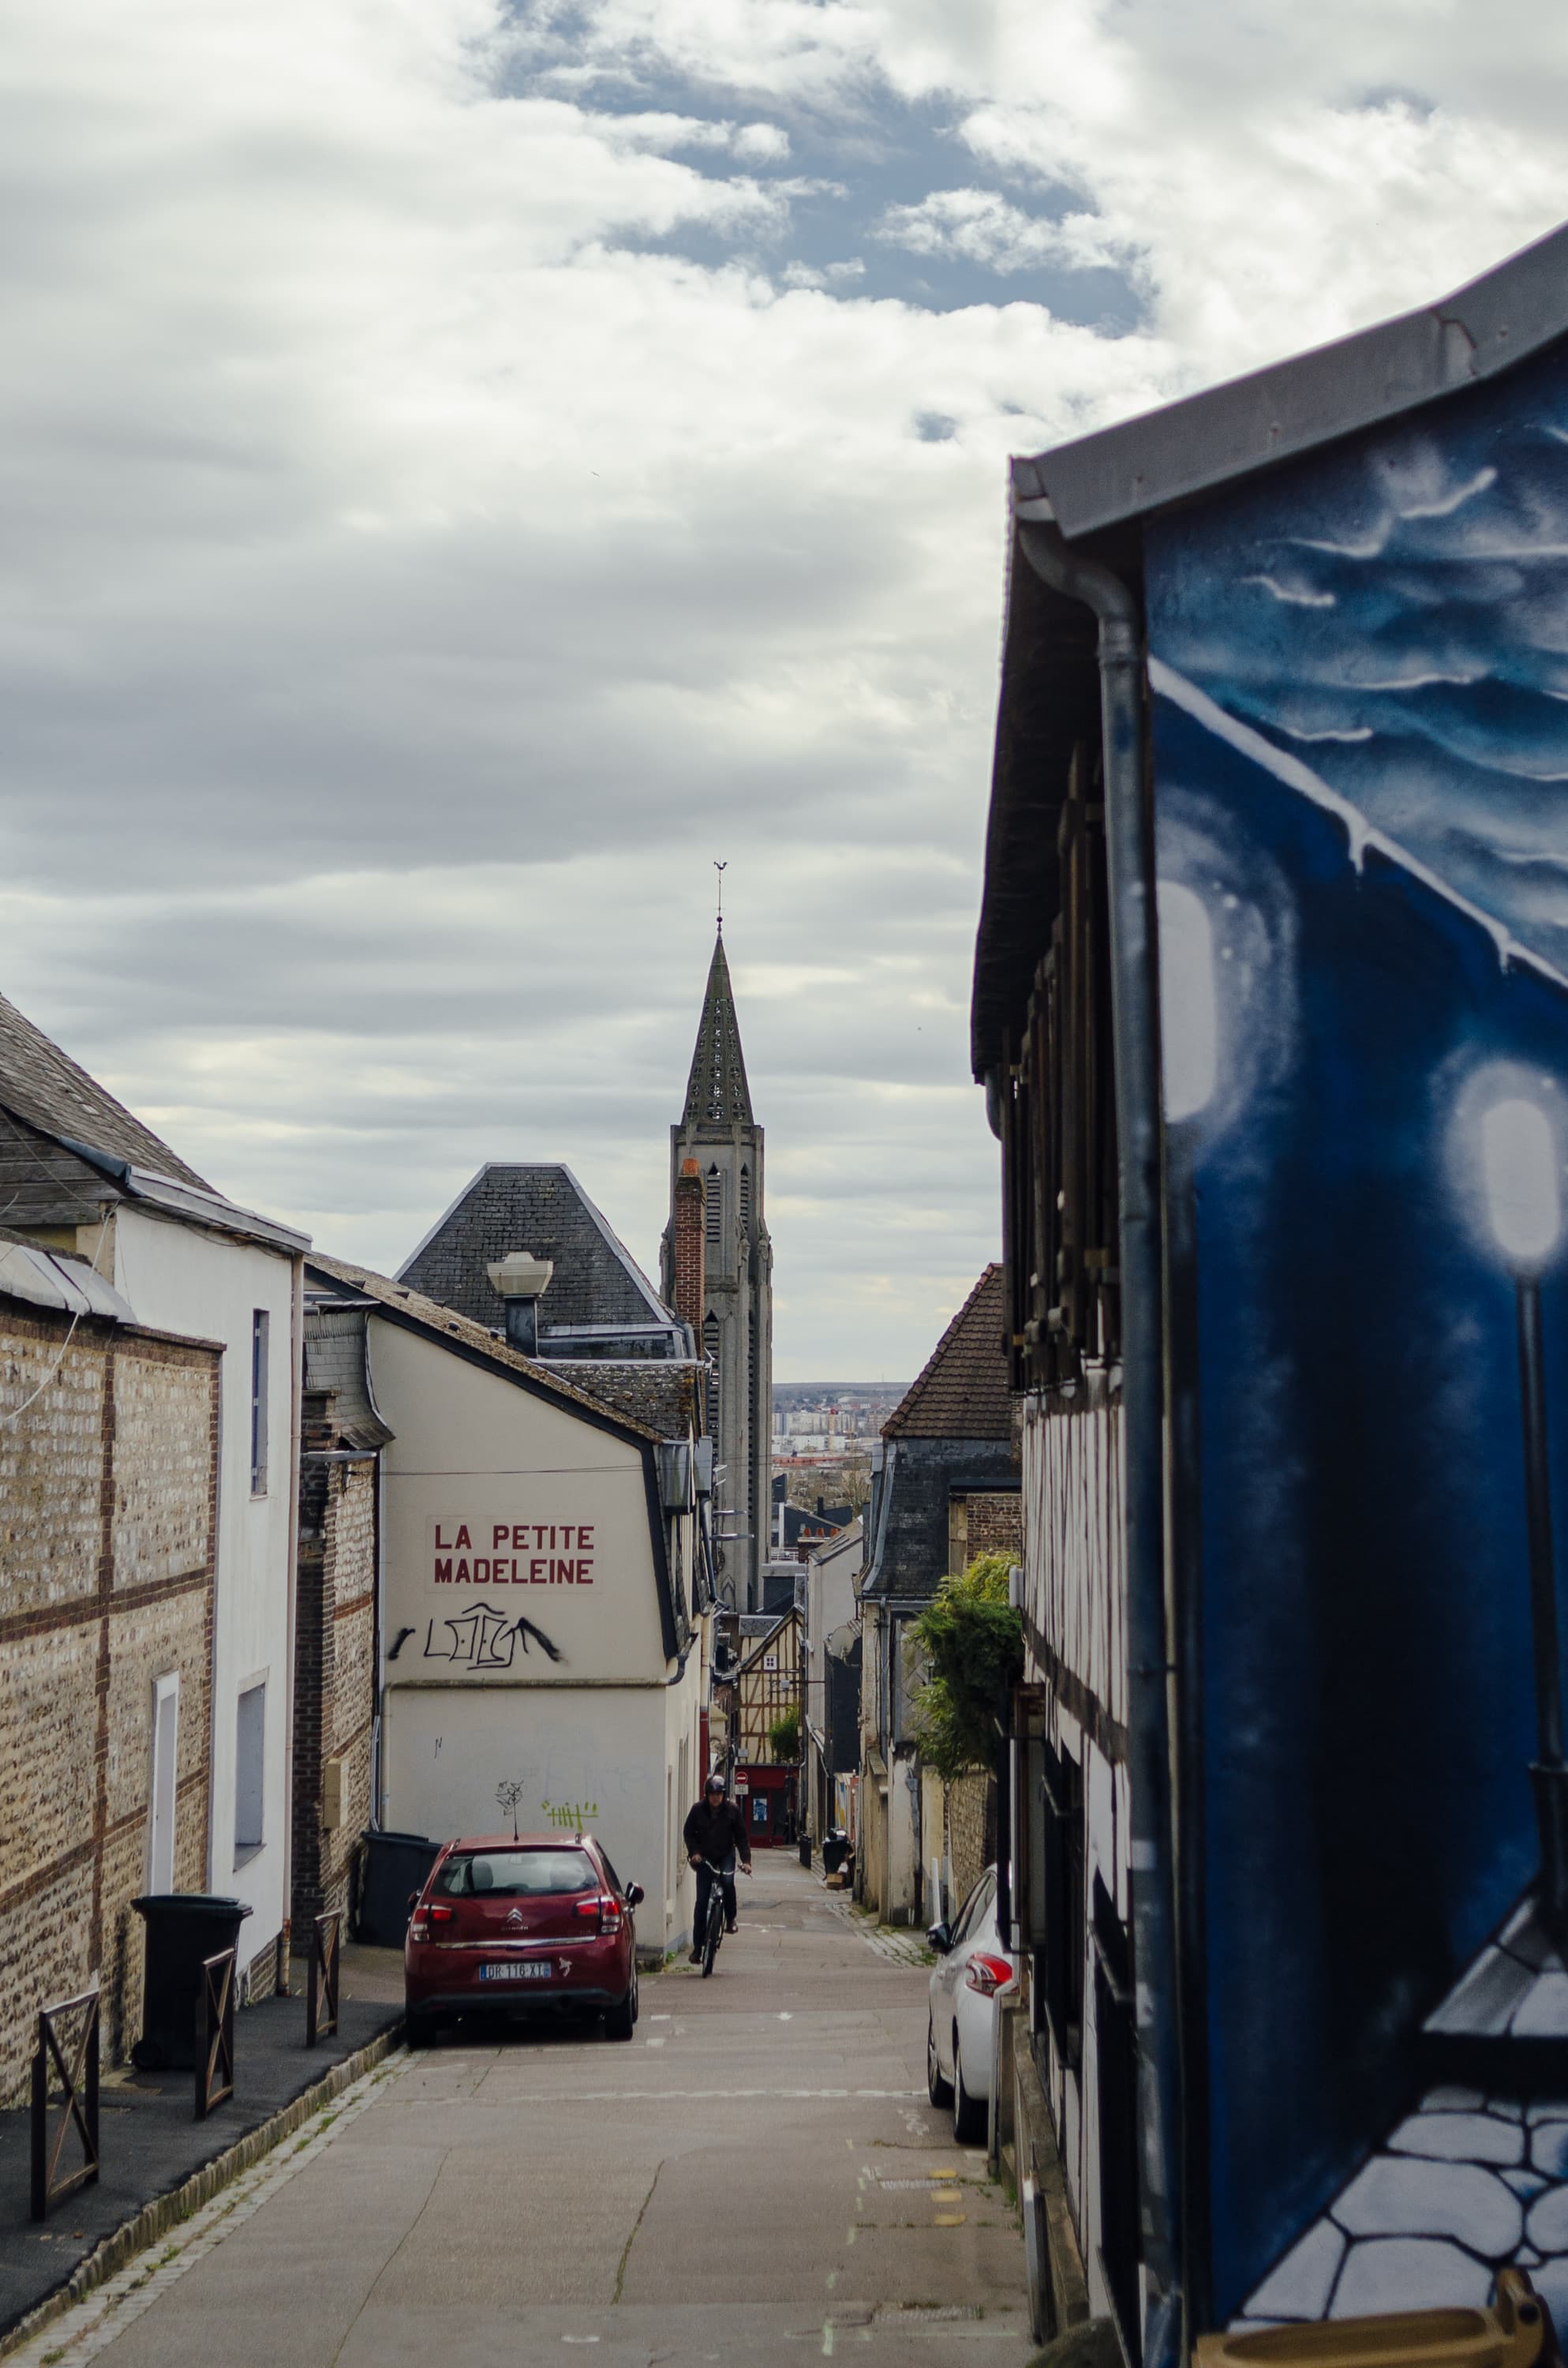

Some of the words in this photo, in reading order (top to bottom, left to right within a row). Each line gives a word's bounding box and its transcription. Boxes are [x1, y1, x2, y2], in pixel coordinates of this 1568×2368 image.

[435, 1524, 472, 1549] LA
[492, 1525, 594, 1549] PETITE
[434, 1558, 594, 1583] MADELEINE
